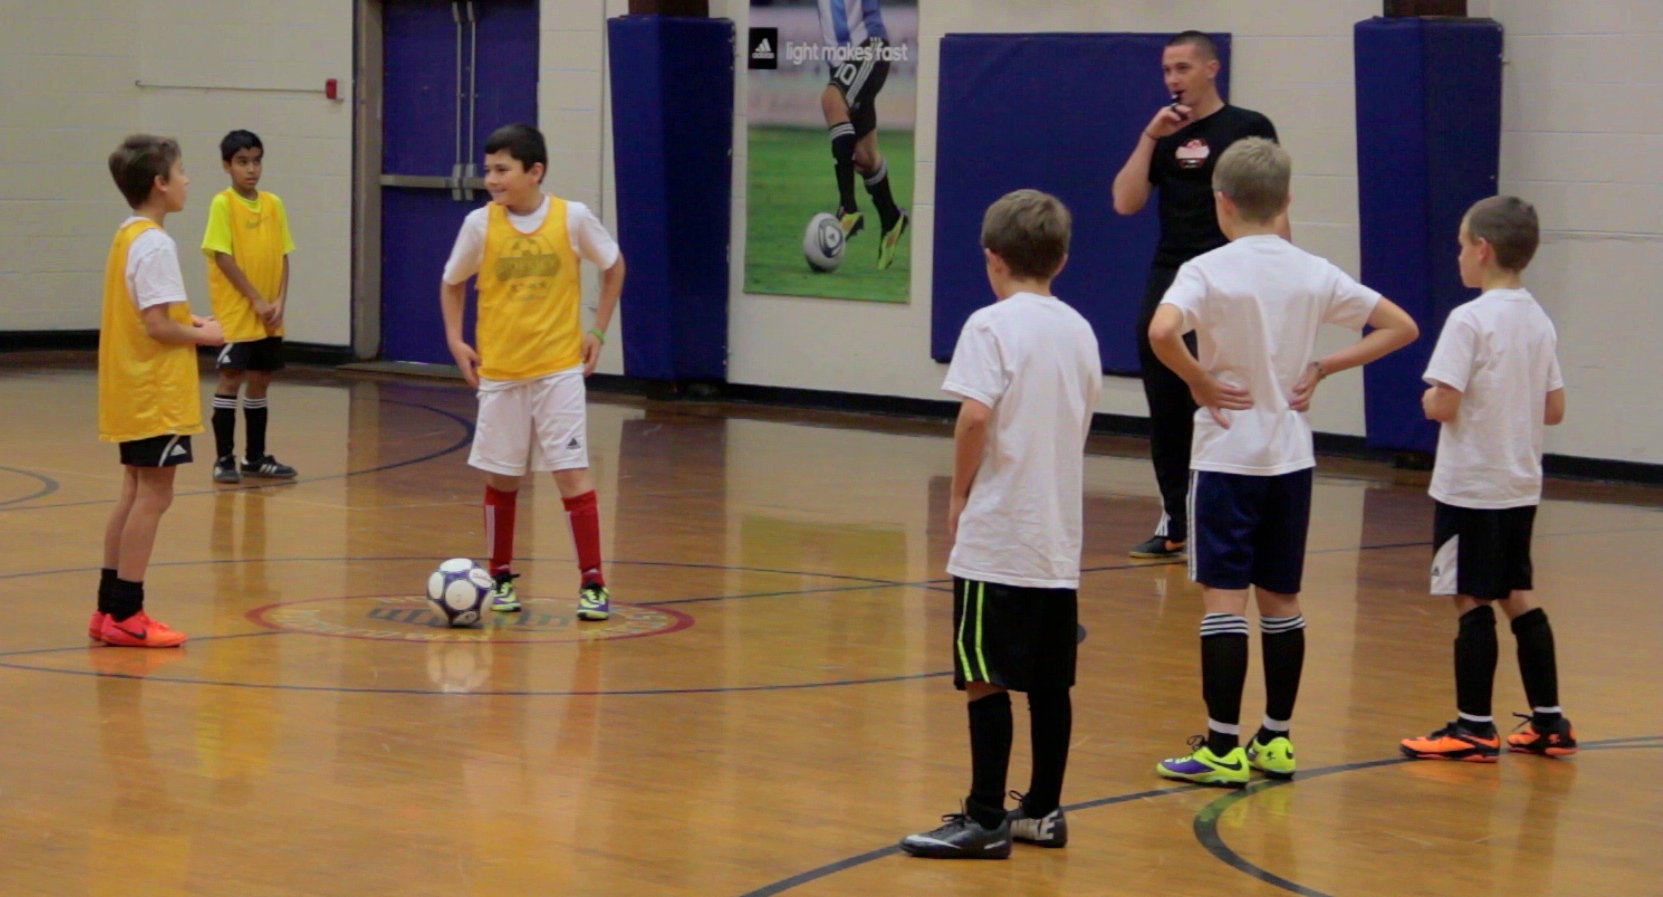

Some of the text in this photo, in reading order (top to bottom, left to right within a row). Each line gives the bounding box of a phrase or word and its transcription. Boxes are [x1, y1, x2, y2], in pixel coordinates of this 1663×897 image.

[786, 41, 908, 65] light makes fast
[834, 63, 857, 85] 10
